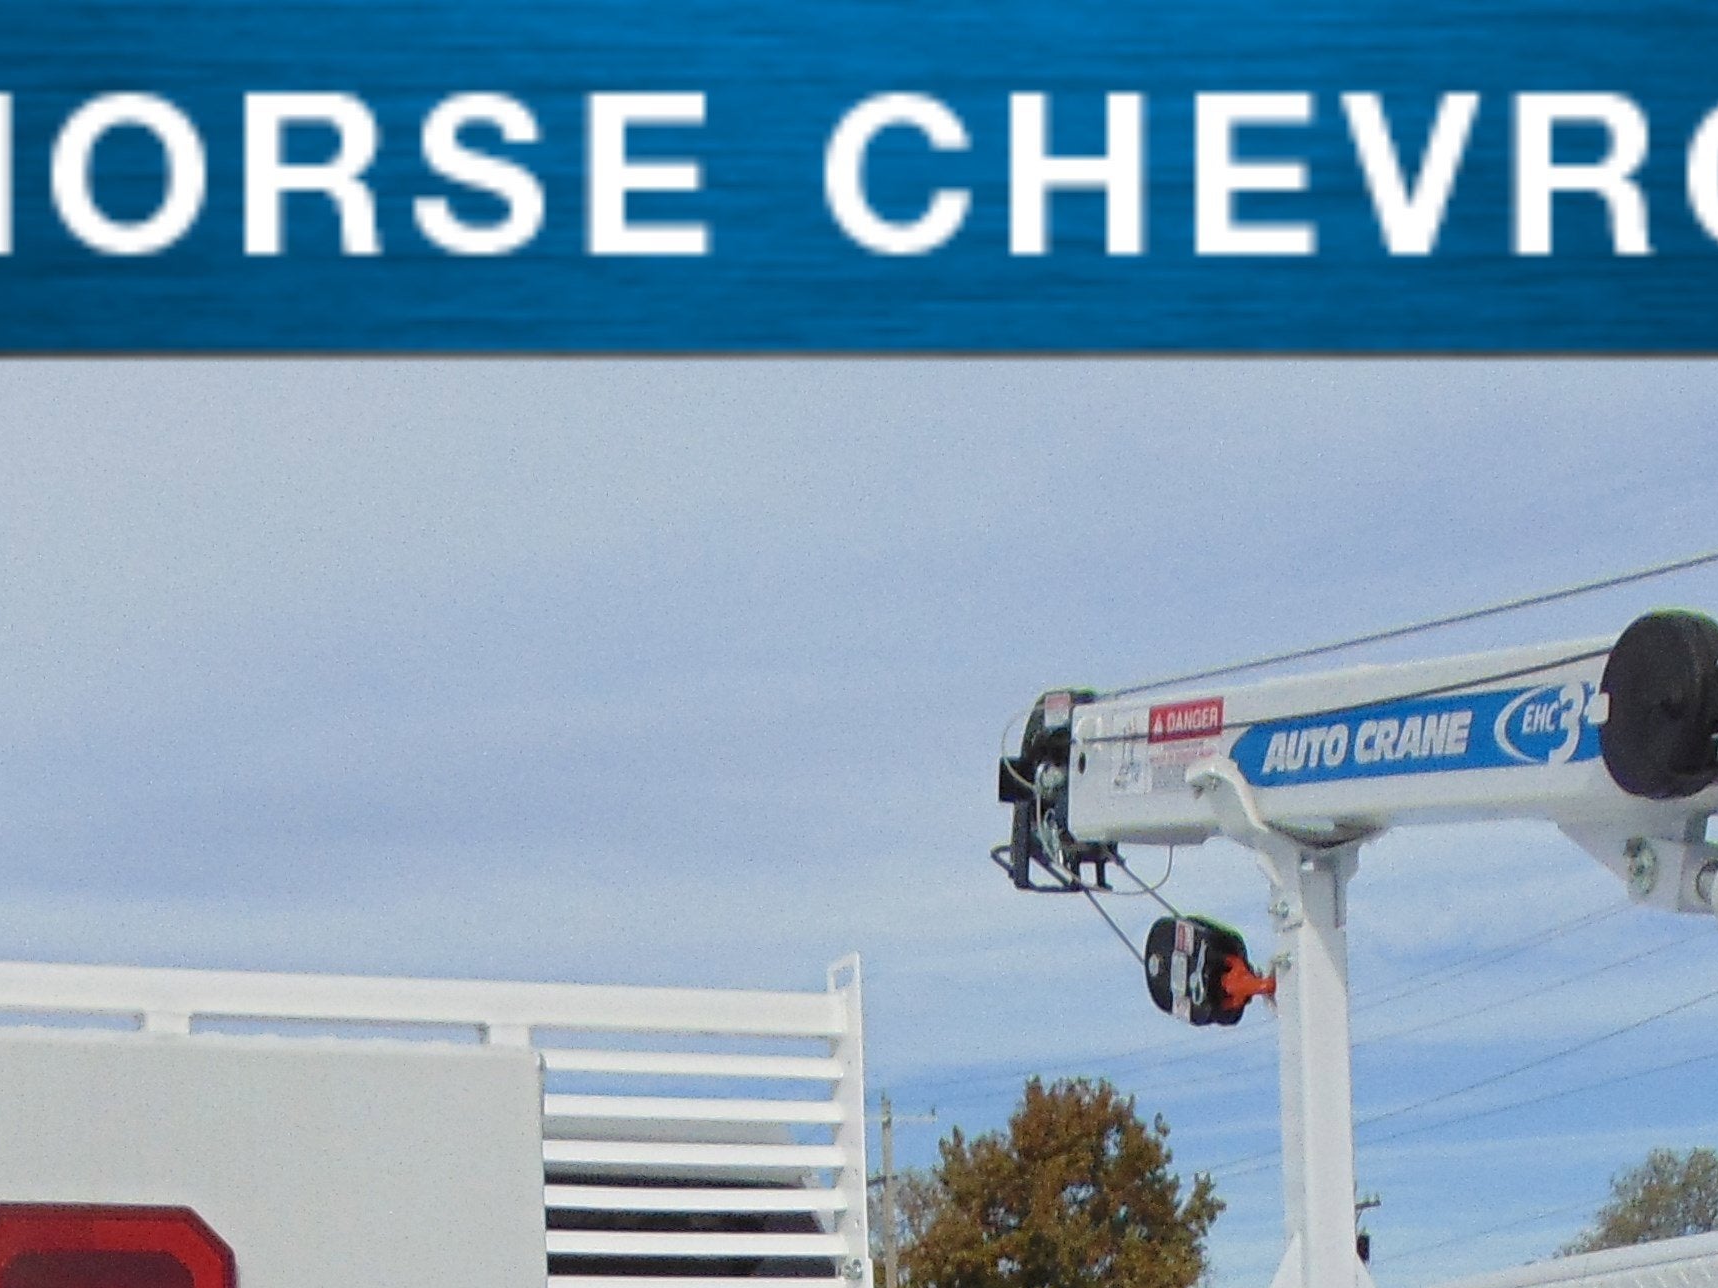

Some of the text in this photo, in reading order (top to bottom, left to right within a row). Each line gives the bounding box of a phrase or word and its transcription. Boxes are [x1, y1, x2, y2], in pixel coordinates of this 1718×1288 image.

[1166, 707, 1219, 733] DANGER
[1261, 724, 1350, 774] AUTO
[1354, 710, 1474, 765] CRANE
[1520, 700, 1562, 736] EHC
